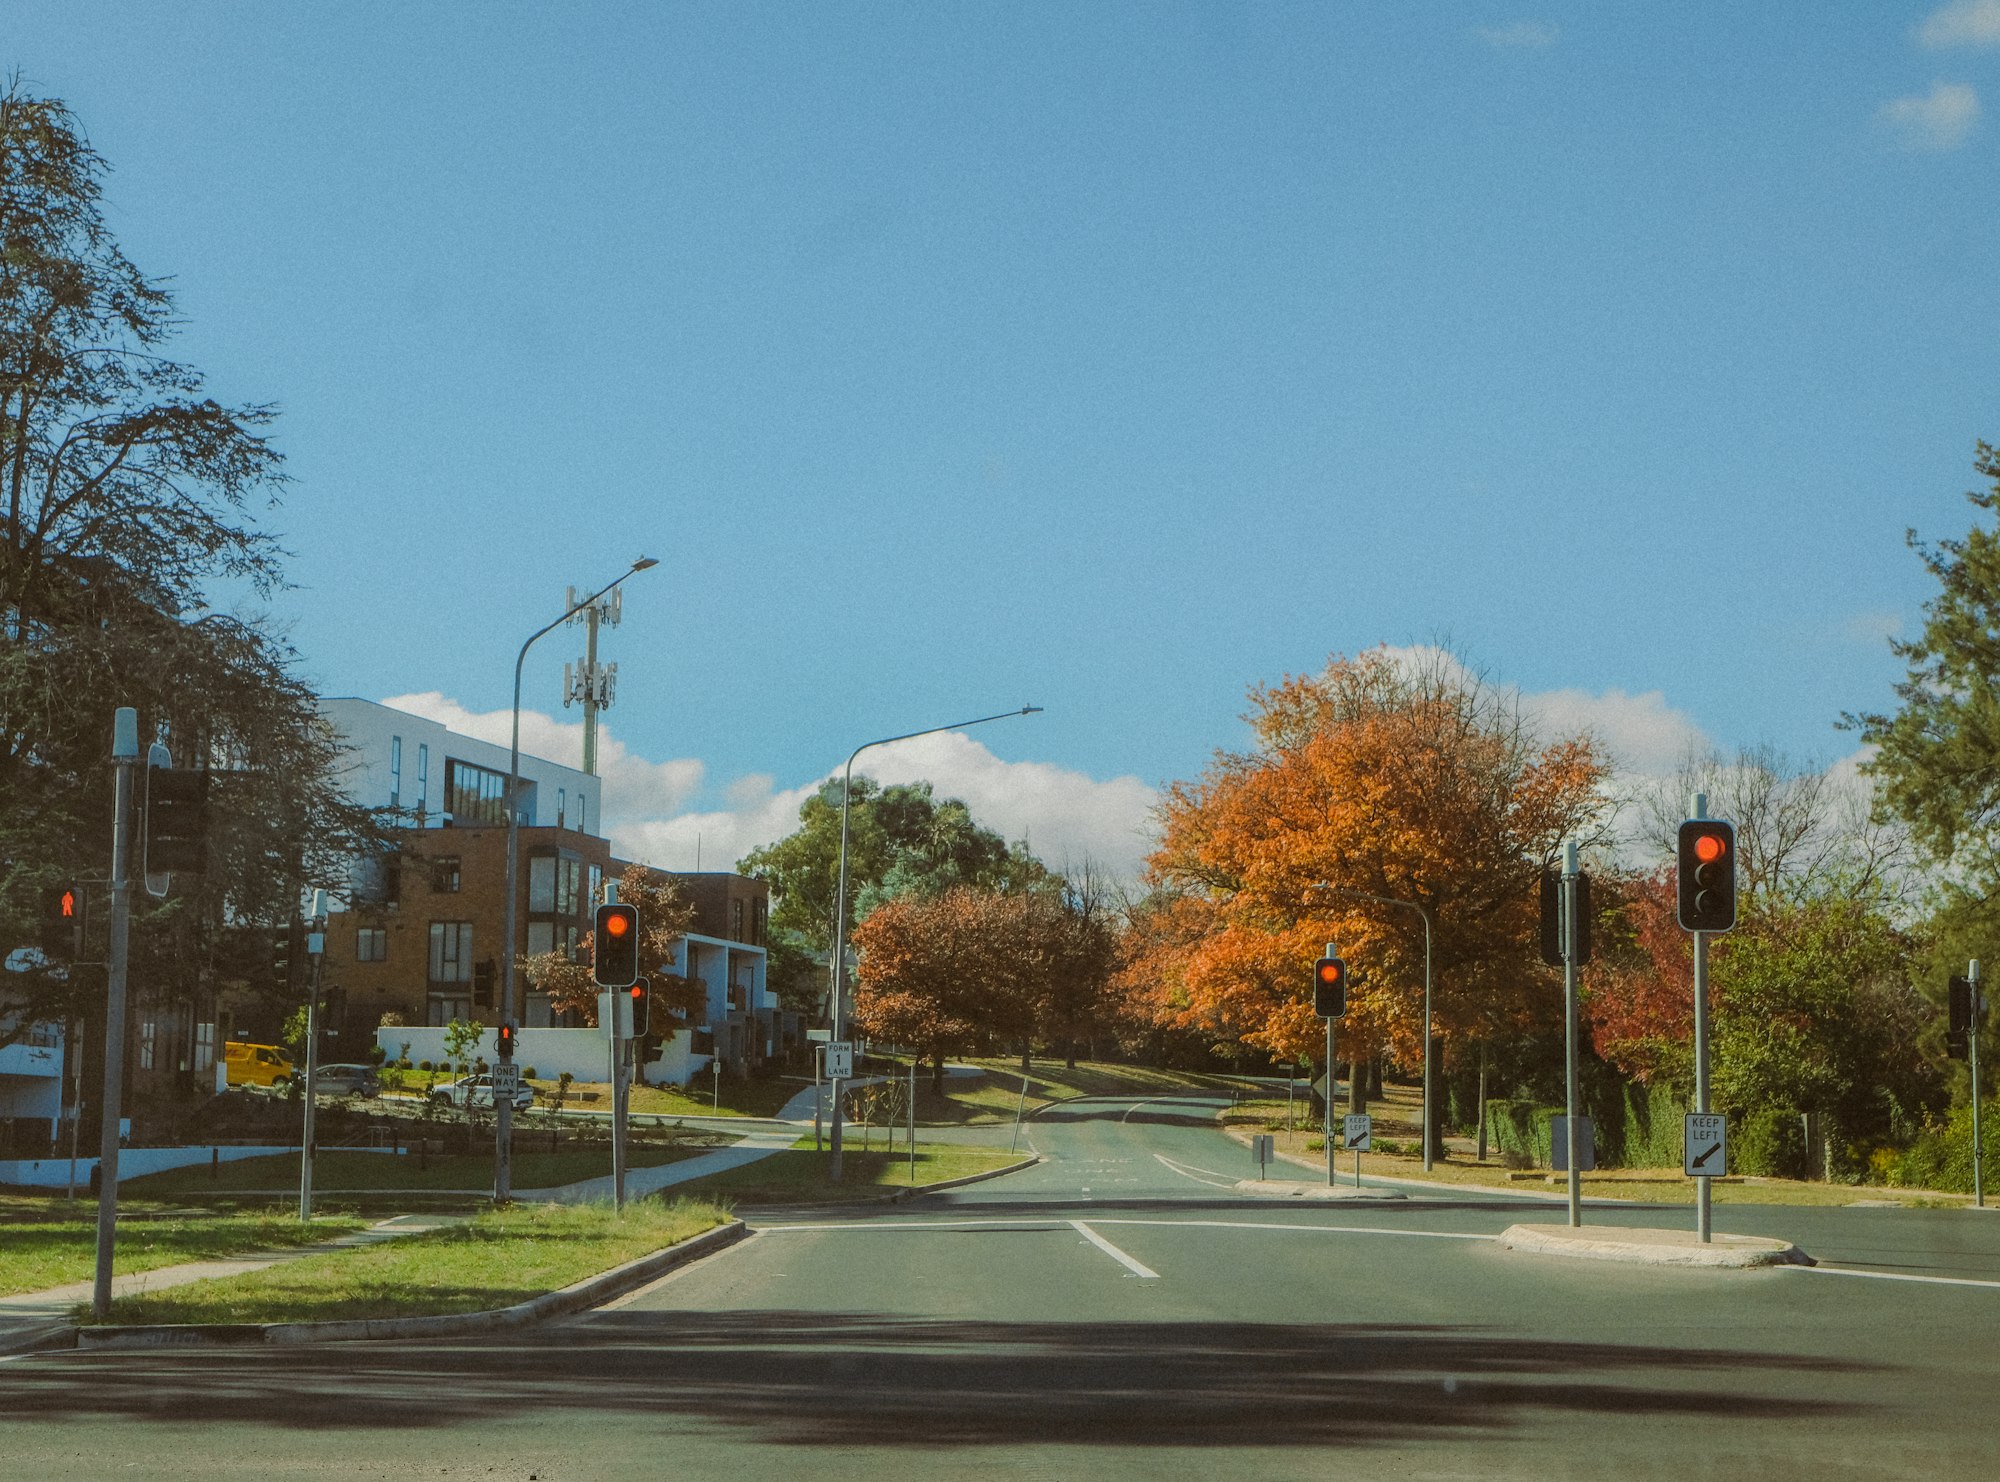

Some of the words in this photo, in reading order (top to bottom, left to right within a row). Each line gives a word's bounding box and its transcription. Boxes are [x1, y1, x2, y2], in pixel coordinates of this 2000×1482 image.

[836, 1054, 841, 1066] 1
[496, 1067, 515, 1076] ONE
[496, 1078, 516, 1086] WAY
[1692, 1118, 1720, 1128] KEEP
[1693, 1130, 1718, 1140] LEFT
